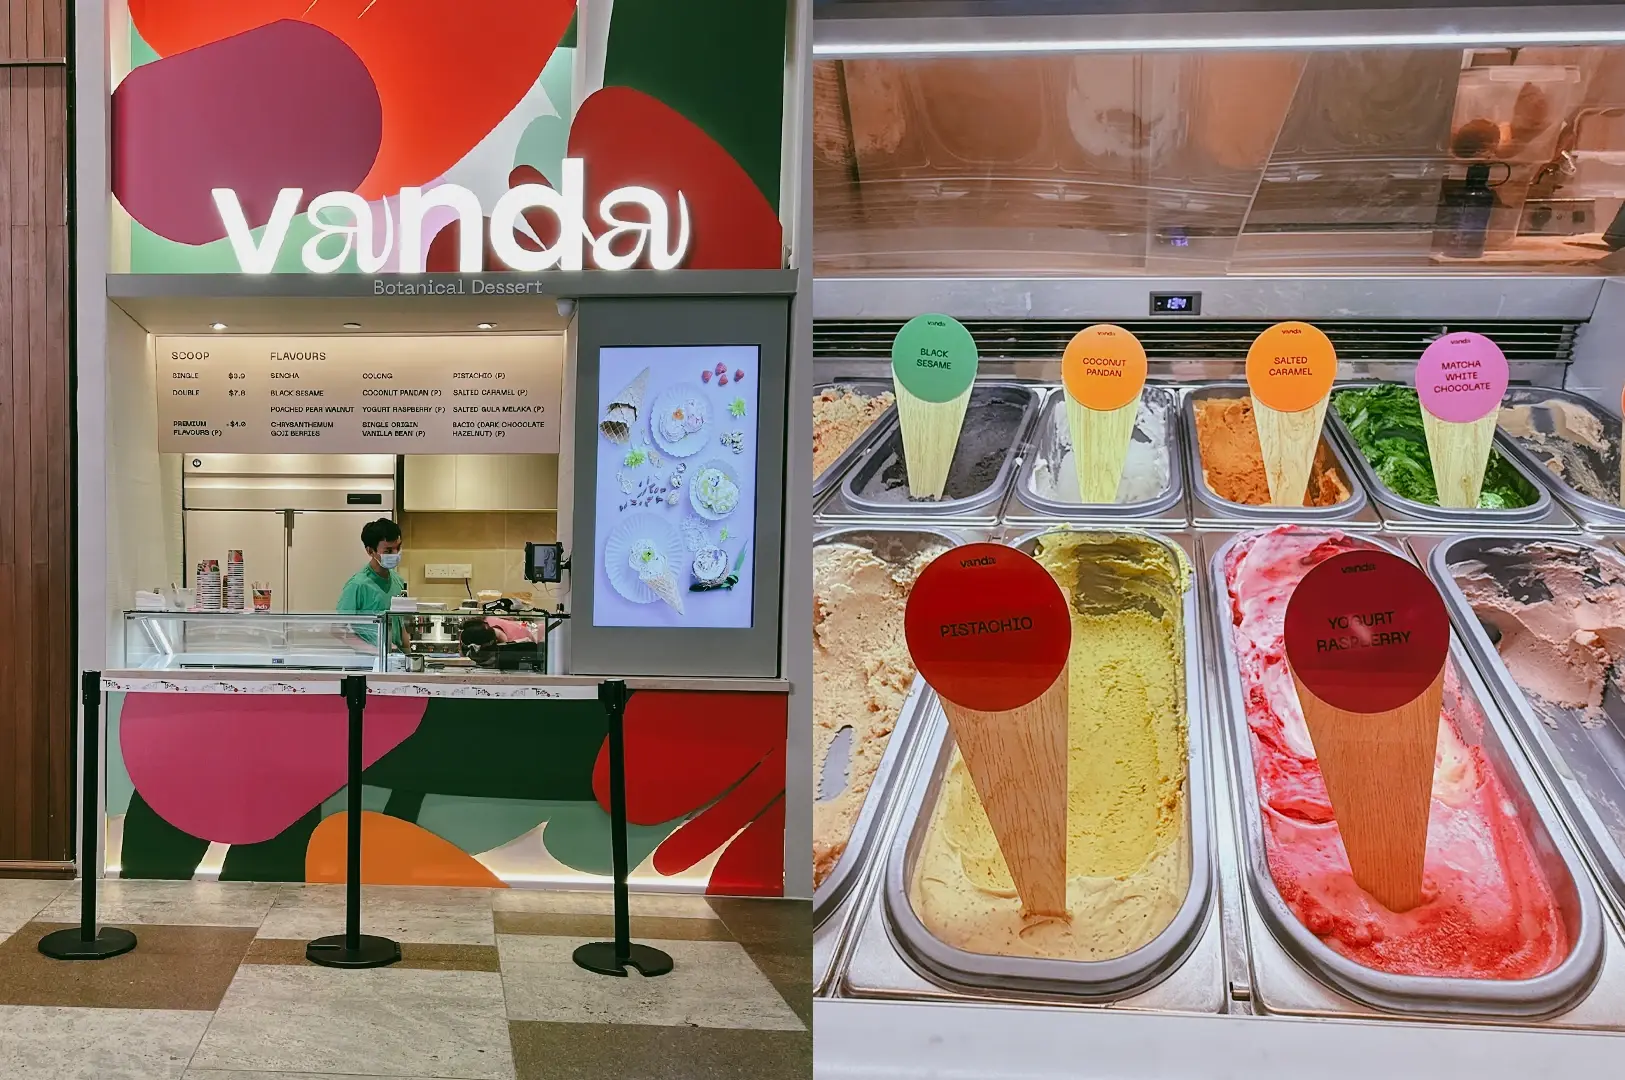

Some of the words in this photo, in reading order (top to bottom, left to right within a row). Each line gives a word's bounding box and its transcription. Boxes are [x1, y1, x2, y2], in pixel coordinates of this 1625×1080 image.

[211, 158, 689, 274] vanda
[374, 280, 465, 295] Botanical
[472, 280, 542, 295] Dessert
[171, 352, 210, 360] SCOOP
[270, 352, 326, 361] FLAVOURS
[920, 348, 949, 358] BLACK
[916, 359, 952, 370] SESAME
[1083, 357, 1127, 366] COCONUT
[1274, 357, 1308, 365] SALTED
[1441, 360, 1482, 370] MATCHA
[1086, 368, 1122, 377] PANDAN
[1269, 368, 1313, 376] CARAMEL
[1445, 372, 1478, 381] WHITE
[1433, 382, 1491, 393] CHOCOLATE
[430, 389, 442, 397] (P)
[211, 429, 222, 437] (P)
[415, 430, 426, 438] (P)
[495, 430, 506, 438] (P)
[960, 556, 996, 568] vanda
[1341, 563, 1376, 573] vanda
[940, 617, 1033, 637] PISTACHIO
